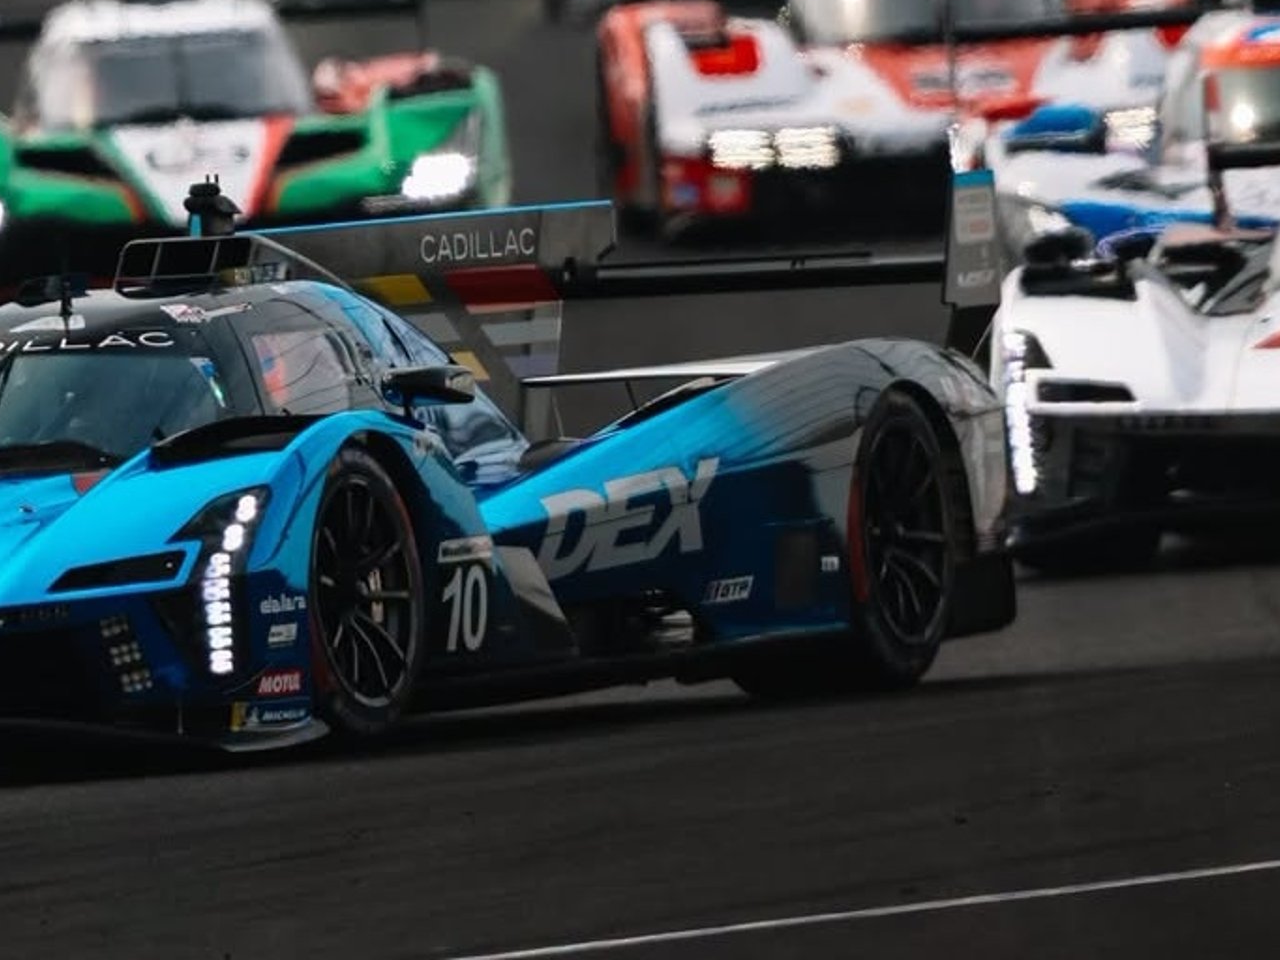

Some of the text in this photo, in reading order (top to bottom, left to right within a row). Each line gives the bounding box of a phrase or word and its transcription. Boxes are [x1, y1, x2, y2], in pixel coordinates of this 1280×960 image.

[420, 227, 535, 263] CADILLAC
[538, 456, 720, 581] DEX
[442, 564, 488, 652] 10
[258, 671, 301, 694] MOTUL
